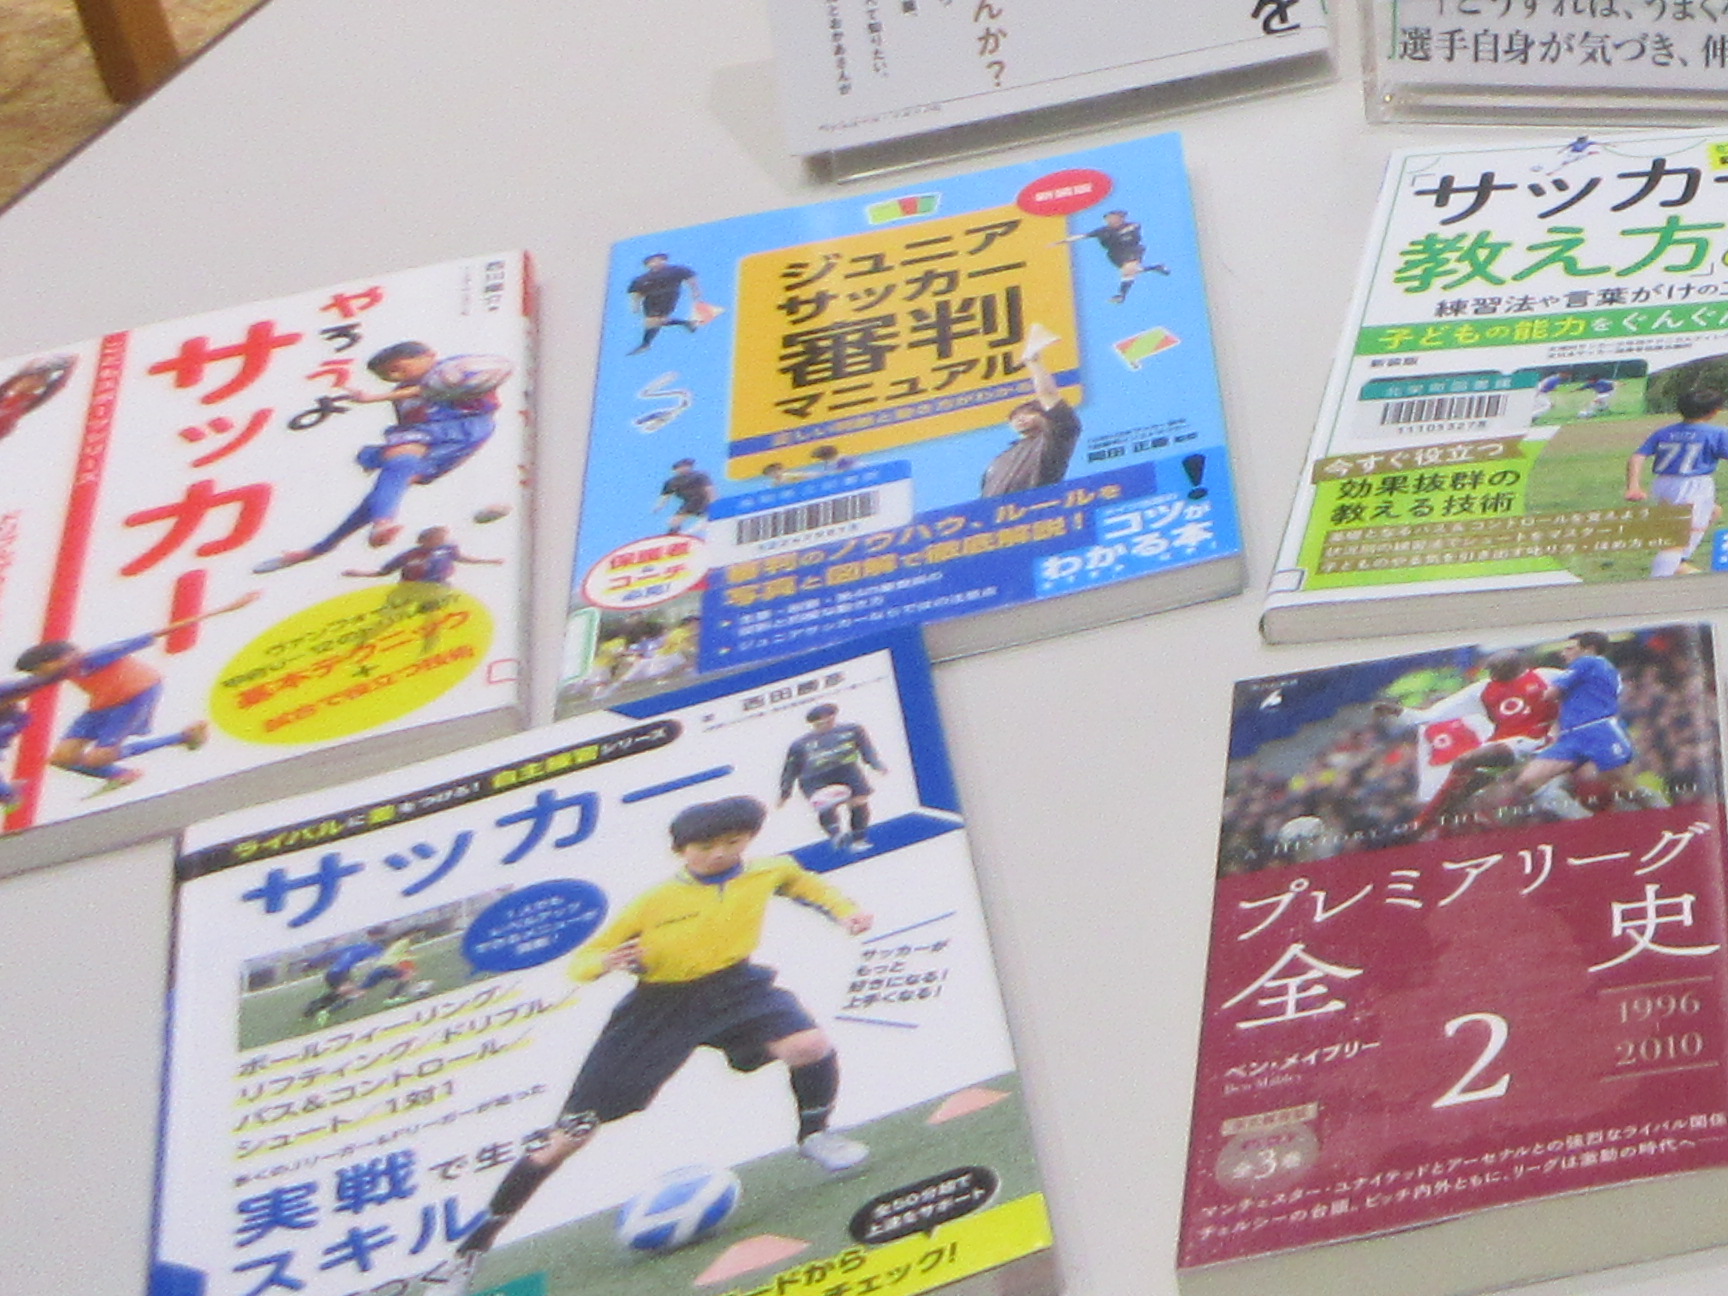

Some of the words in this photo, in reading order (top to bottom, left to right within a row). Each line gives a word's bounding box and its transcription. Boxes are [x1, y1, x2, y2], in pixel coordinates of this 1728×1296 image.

[780, 218, 1024, 292] ジュニア
[777, 260, 1027, 325] サッカー
[776, 285, 1024, 389] 審判
[774, 356, 1029, 419] マニュアル
[121, 319, 304, 656] サッカー
[1329, 491, 1516, 525] 教える技術
[1336, 467, 1523, 503] 効果抜群の
[241, 763, 735, 928] サッカー
[1237, 819, 1712, 942] プレミアリーグ
[1431, 1010, 1512, 1109] 2
[1615, 1032, 1704, 1067] 2010
